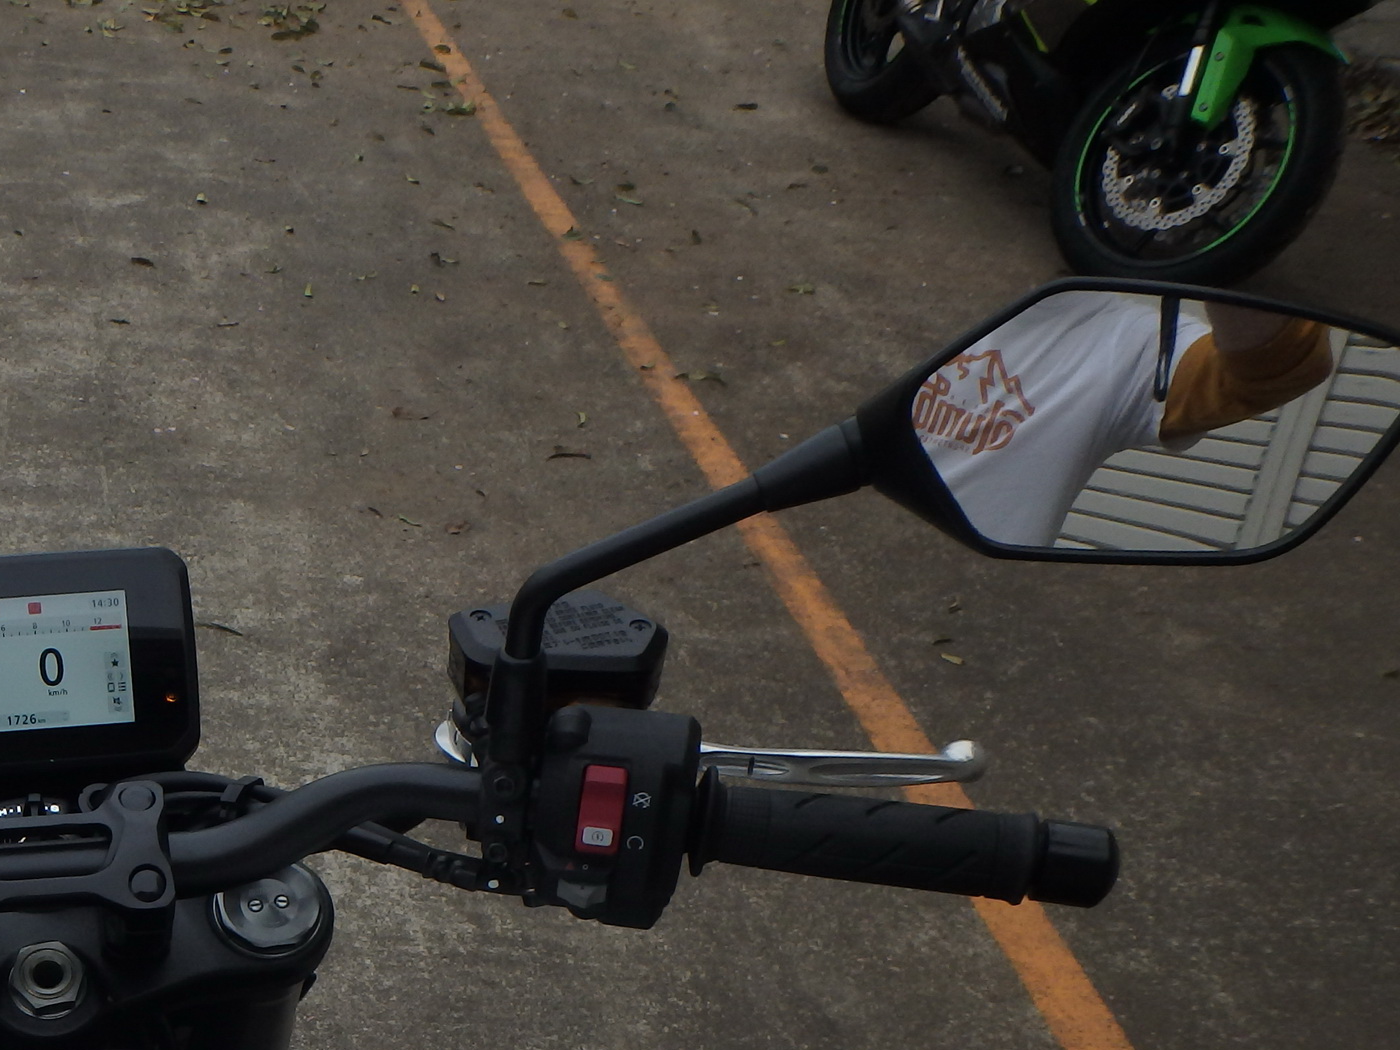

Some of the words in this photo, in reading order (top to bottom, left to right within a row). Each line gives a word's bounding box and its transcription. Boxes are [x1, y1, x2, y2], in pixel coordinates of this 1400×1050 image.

[91, 598, 120, 608] 14:30
[62, 619, 71, 627] 10
[93, 617, 102, 625] 12
[39, 647, 64, 687] 0
[48, 689, 68, 697] km/h
[8, 713, 37, 726] 1726
